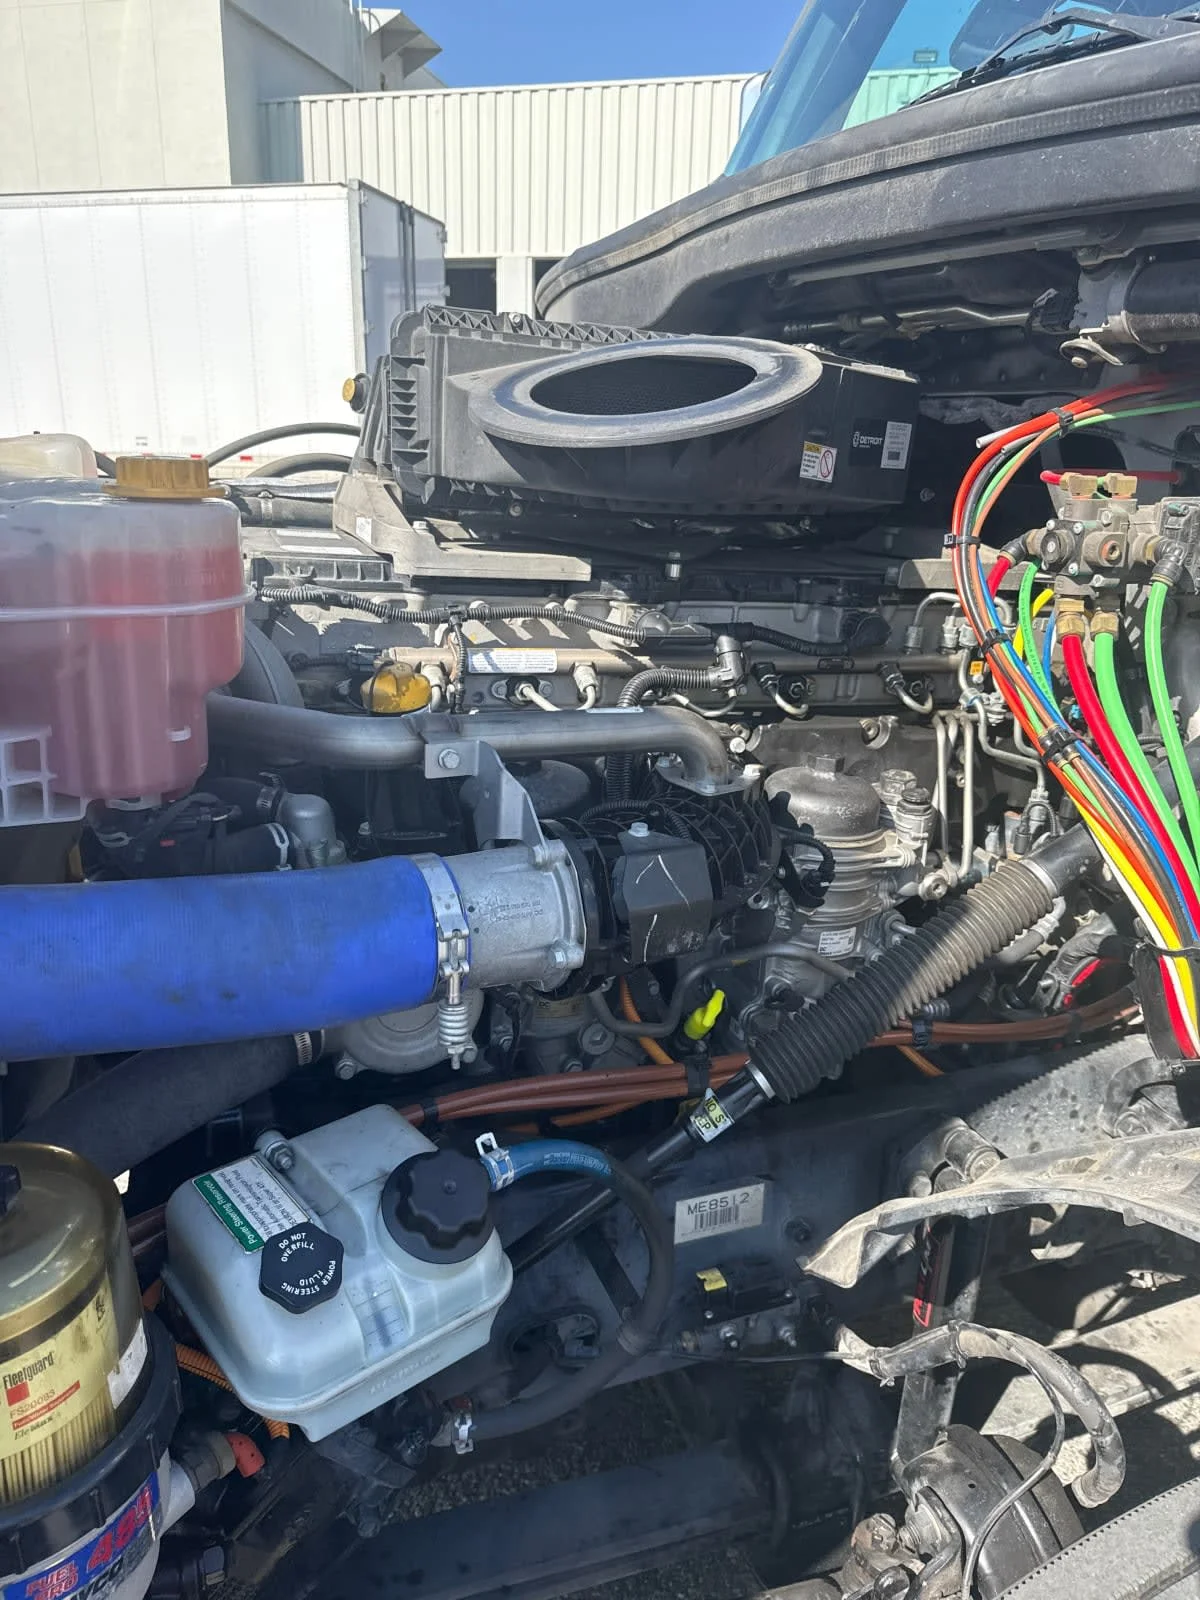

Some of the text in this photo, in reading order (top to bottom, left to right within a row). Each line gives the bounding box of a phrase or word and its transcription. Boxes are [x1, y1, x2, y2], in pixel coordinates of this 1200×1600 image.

[860, 436, 883, 446] DETROIT
[202, 1179, 258, 1245] Power Steering Reservoir
[687, 1192, 750, 1216] ME8512
[278, 1232, 306, 1250] DO NOT
[281, 1241, 315, 1262] OVERFILL
[281, 1260, 336, 1296] POWER STEERING
[299, 1270, 324, 1286] FLUID
[2, 1351, 54, 1389] Fleetguard
